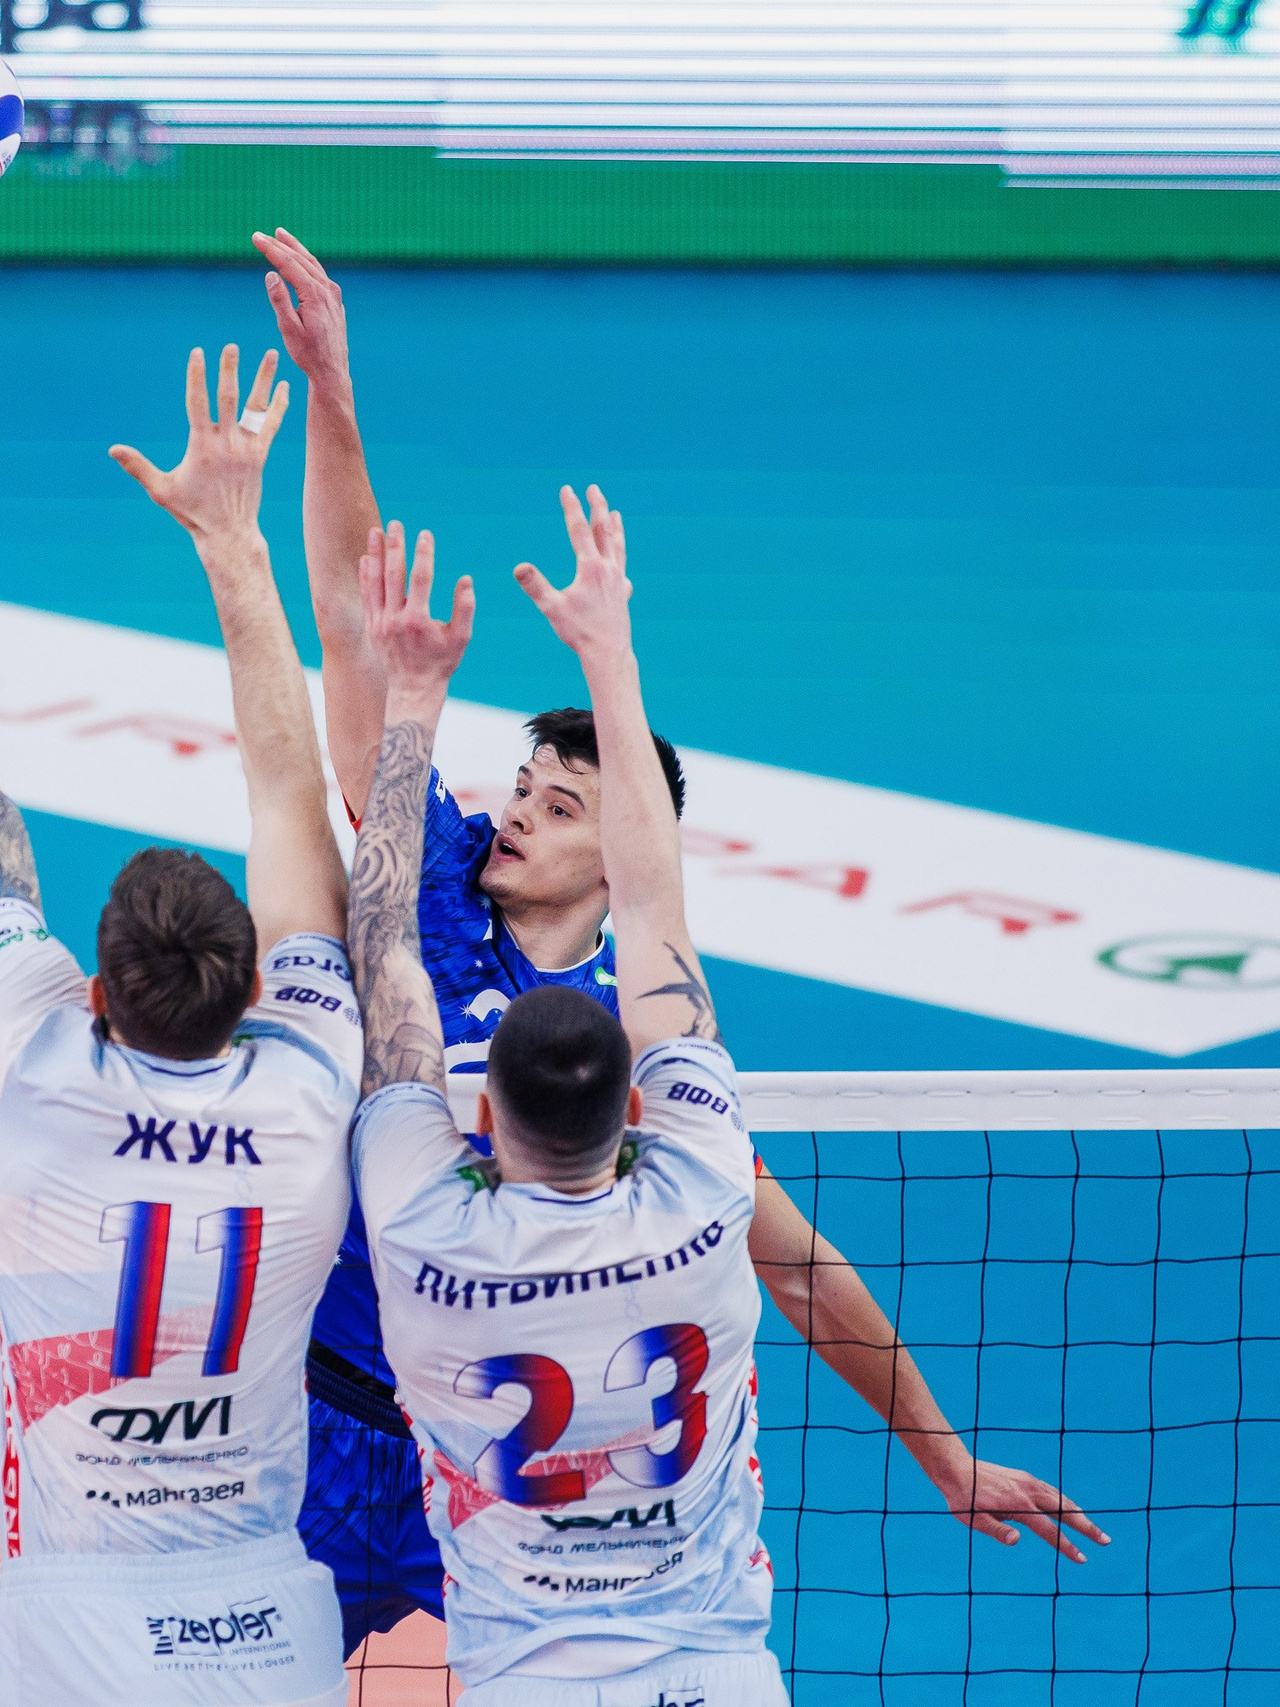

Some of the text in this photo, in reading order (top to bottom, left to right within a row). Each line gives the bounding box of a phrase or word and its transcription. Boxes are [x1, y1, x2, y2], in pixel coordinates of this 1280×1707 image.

[114, 1112, 262, 1165] ЖУК
[99, 1200, 263, 1379] 11
[453, 1322, 710, 1507] 23
